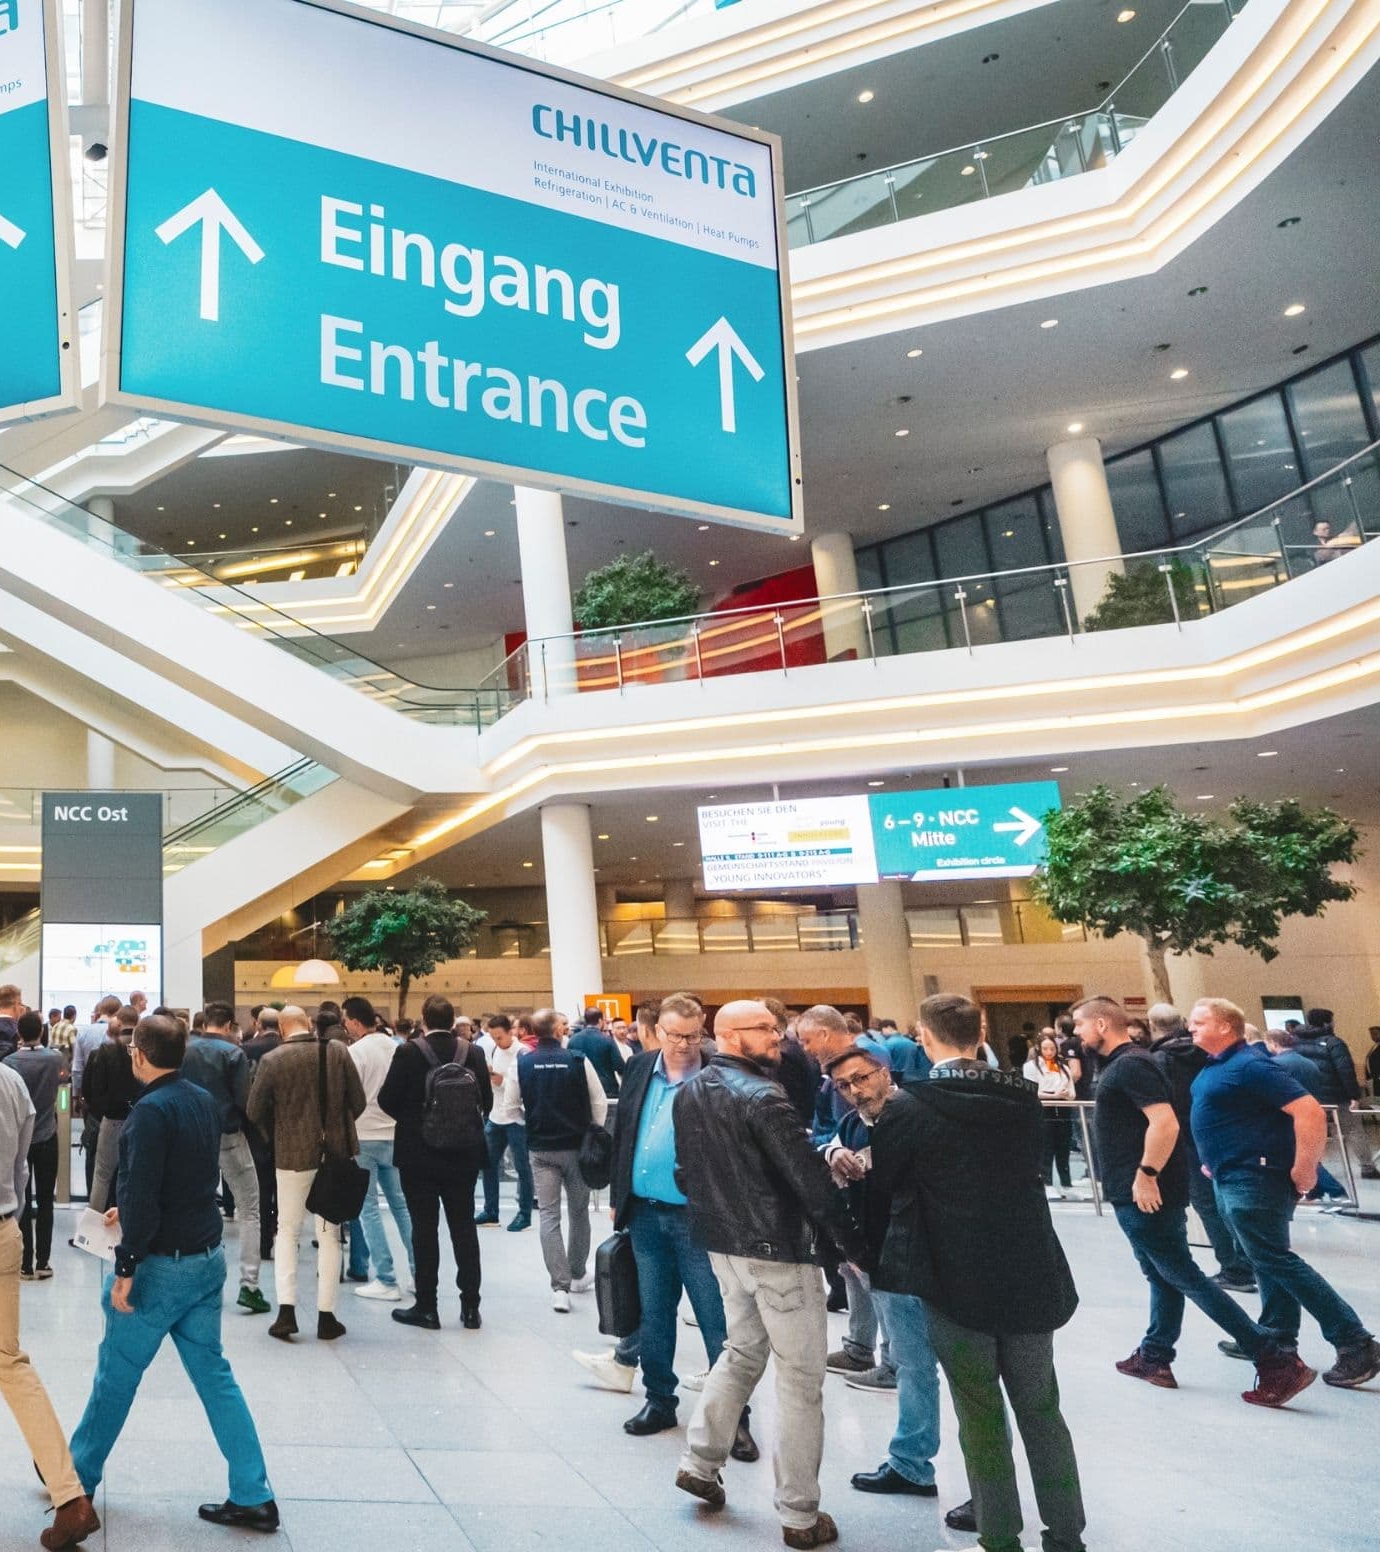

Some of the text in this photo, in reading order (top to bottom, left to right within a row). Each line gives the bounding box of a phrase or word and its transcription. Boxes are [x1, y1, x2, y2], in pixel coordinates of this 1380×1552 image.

[533, 160, 654, 203] International Exhibition
[534, 177, 603, 205] Refrigeration
[611, 199, 627, 213] AC
[630, 203, 638, 215] &
[640, 207, 694, 231] Ventilation
[703, 223, 725, 239] Heat
[728, 230, 760, 249] Pumps
[320, 194, 621, 350] Eingang
[320, 312, 647, 448] Entrance
[54, 806, 129, 822] NCC Ost
[701, 806, 755, 819] BESUCHEN
[775, 804, 797, 814] DEN
[939, 809, 980, 827] NCC
[911, 830, 956, 847] Mitte
